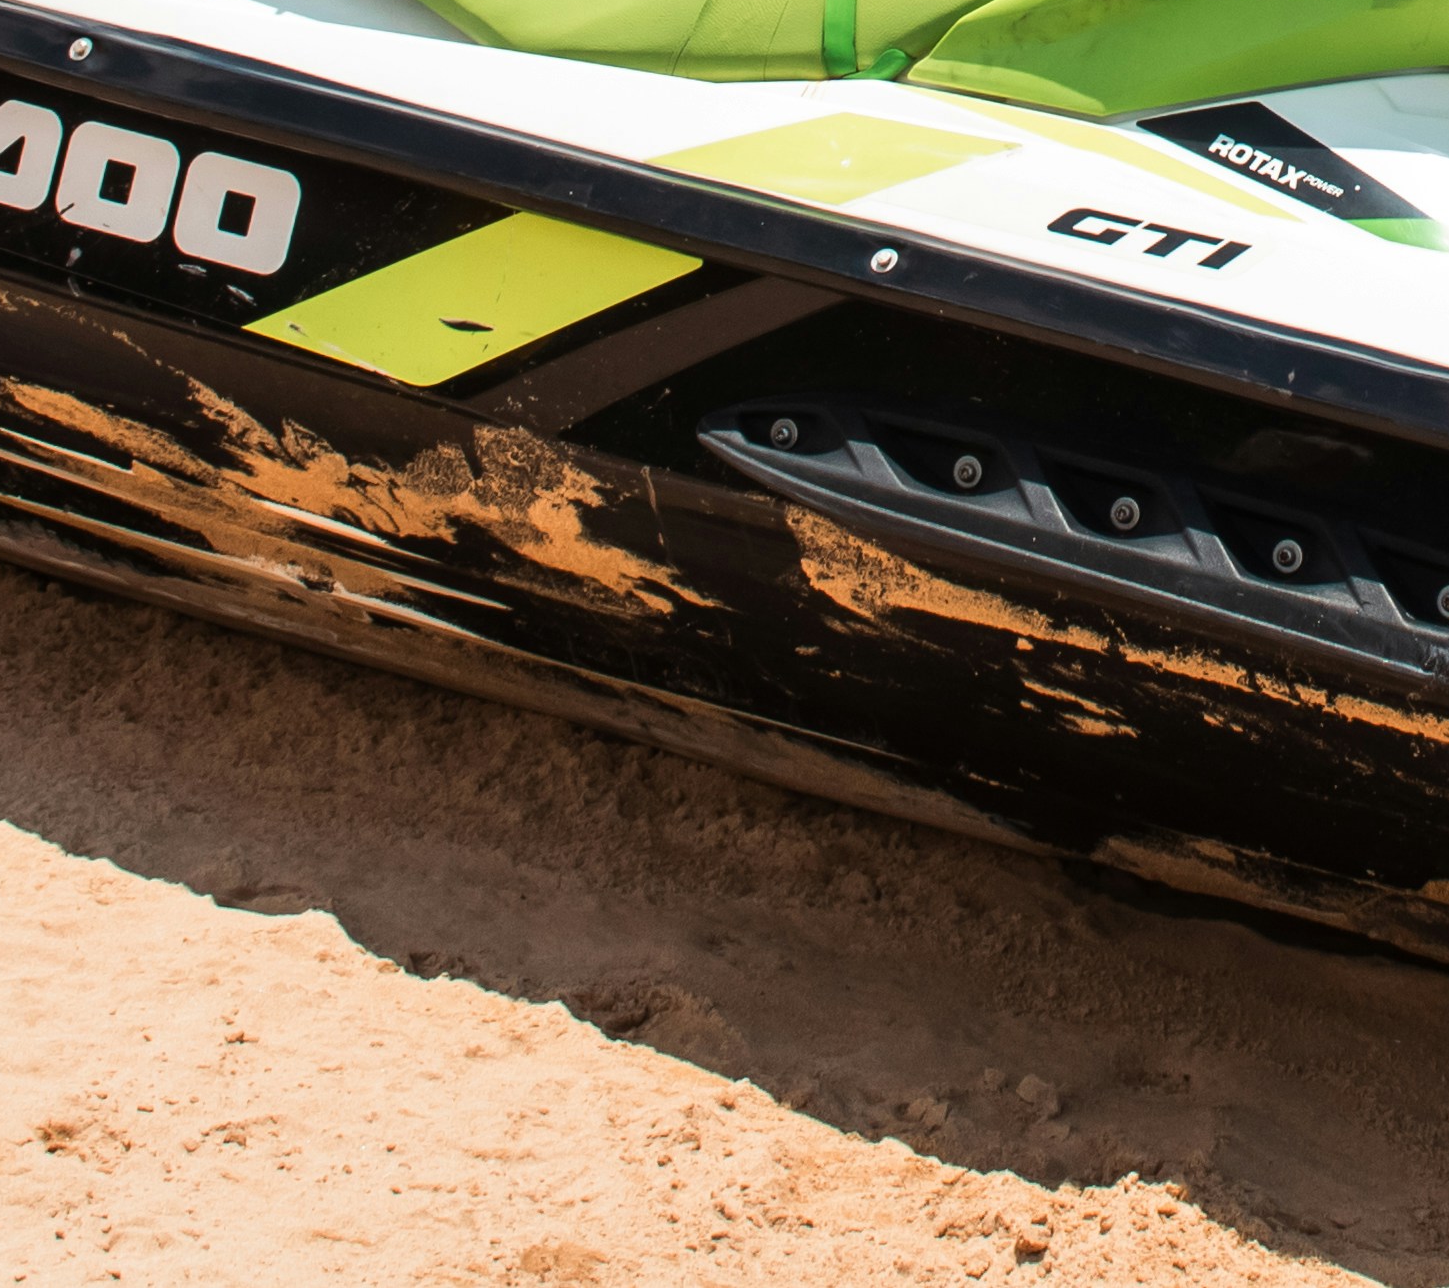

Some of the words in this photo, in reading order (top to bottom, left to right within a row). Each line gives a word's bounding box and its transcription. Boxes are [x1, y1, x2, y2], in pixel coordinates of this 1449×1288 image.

[1207, 133, 1306, 190] ROTAX
[1302, 173, 1344, 199] POWER
[1046, 208, 1252, 270] GTI
